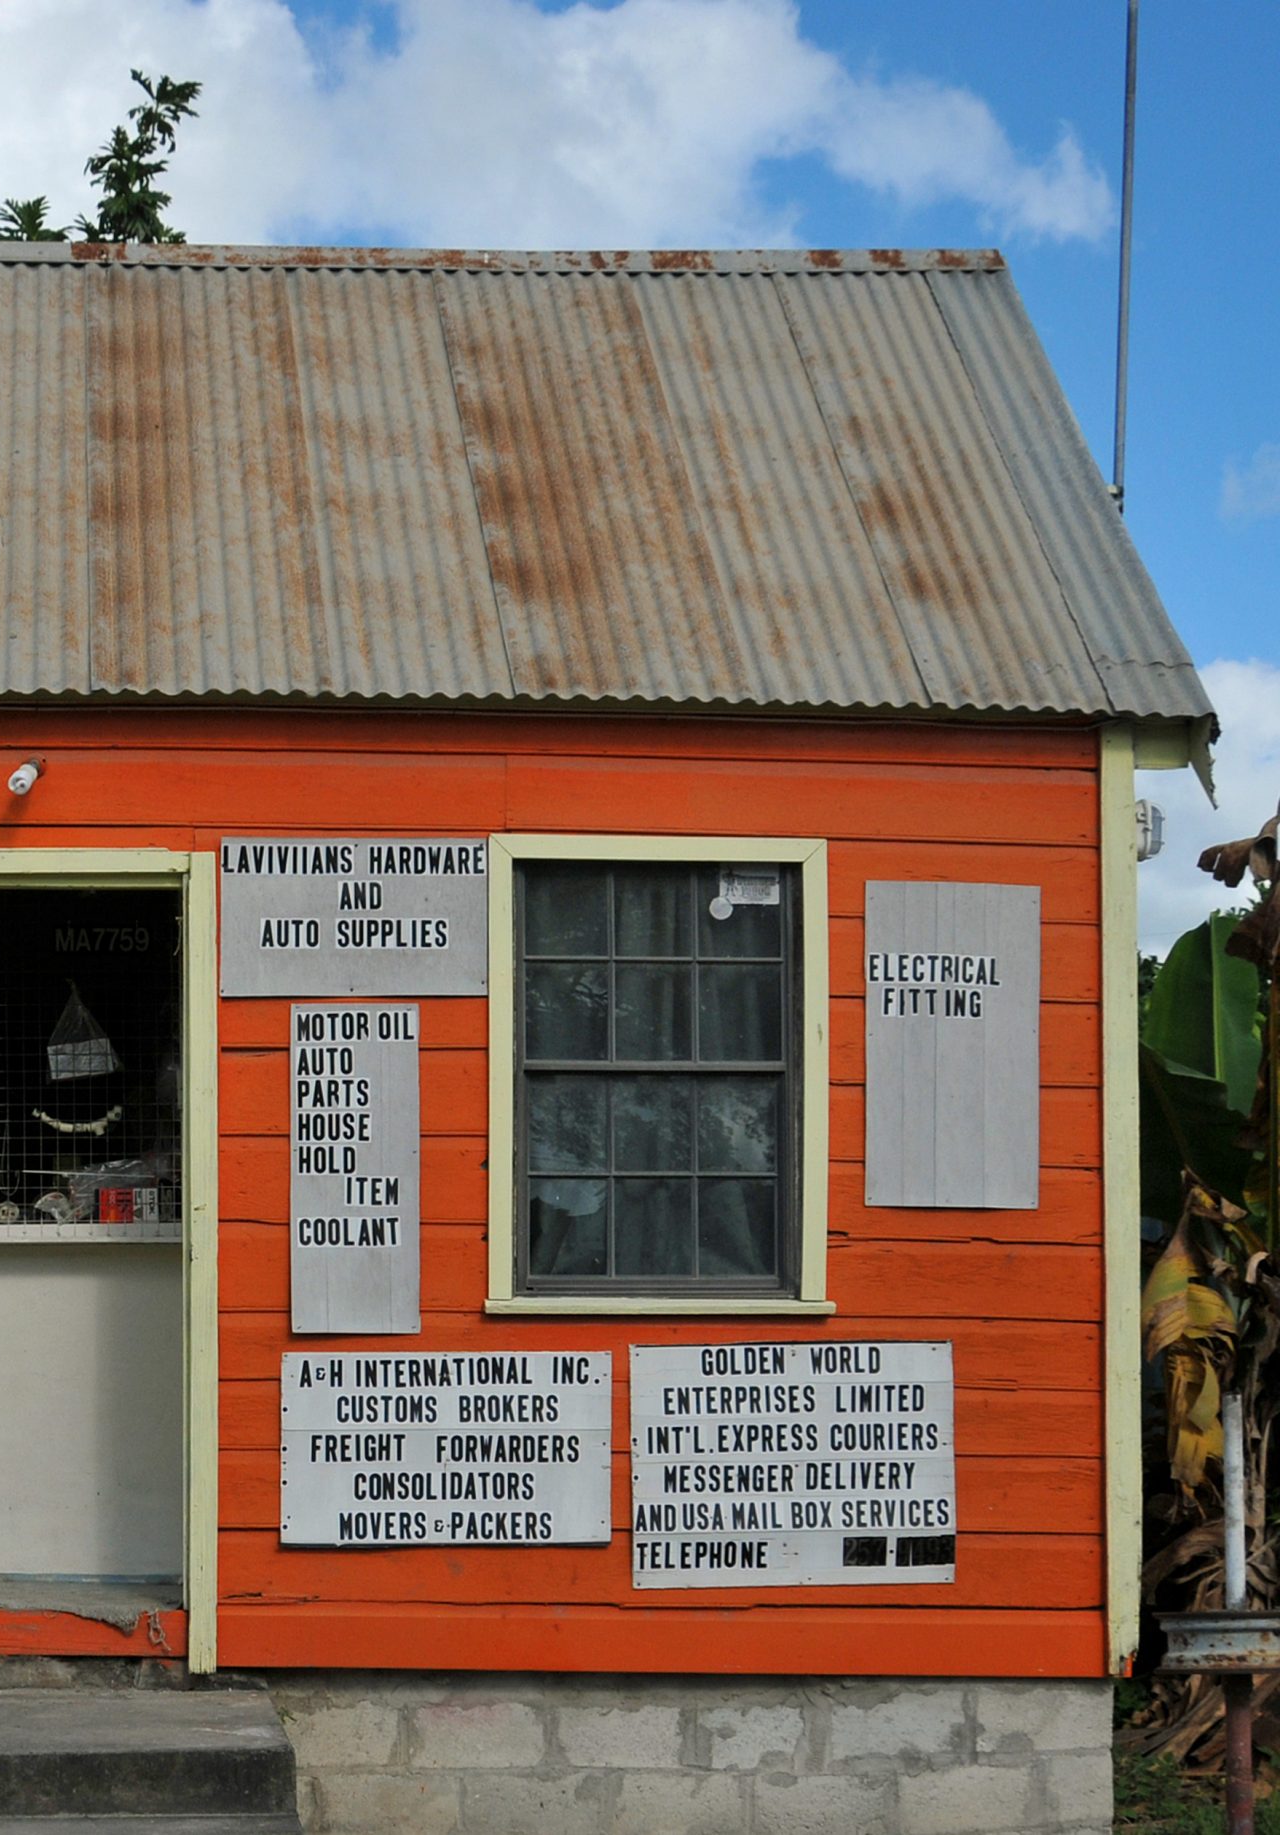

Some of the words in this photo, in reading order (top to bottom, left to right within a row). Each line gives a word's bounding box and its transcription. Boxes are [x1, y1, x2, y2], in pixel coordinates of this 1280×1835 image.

[222, 845, 353, 875] LAVIVIIANS
[369, 843, 485, 875] HARDWARE
[339, 882, 382, 910] AND
[55, 927, 151, 952] MA7759
[261, 919, 319, 948] AUTO
[337, 919, 447, 948] SUPPLIES
[869, 953, 1000, 986] ELECTRICAL
[297, 1012, 369, 1042] MOTOR
[378, 1012, 415, 1040] OIL
[297, 1047, 353, 1076] AUTO
[297, 1079, 369, 1109] PARTS
[298, 1112, 370, 1142] HOUSE
[298, 1145, 356, 1174] HOLD
[346, 1176, 399, 1206] ITEM
[299, 1217, 399, 1247] COOLANT
[355, 1356, 533, 1388] INTERNATIONAL
[552, 1356, 600, 1385] INC.
[701, 1346, 785, 1376] GOLDEN
[810, 1346, 880, 1374] WORLD
[337, 1395, 437, 1423] CUSTOMS
[459, 1394, 558, 1423] BROKERS
[663, 1385, 815, 1415] ENTERPRISES
[836, 1384, 924, 1413] LIMITED
[311, 1433, 406, 1463] FREIGHT
[436, 1434, 580, 1463] FORWARDERS
[830, 1423, 938, 1451] COURIERS
[354, 1471, 534, 1501] CONSOLIDATORS
[664, 1464, 793, 1493] MESSENGER
[806, 1462, 915, 1490] DELIVERY
[339, 1512, 427, 1540] MOVERS
[451, 1511, 552, 1540] PACKERS
[635, 1504, 676, 1532] AND
[682, 1503, 724, 1531] USA
[732, 1502, 782, 1530] MAIL
[791, 1501, 832, 1529] BOX
[841, 1498, 949, 1528] SERVICES
[636, 1540, 769, 1570] TELEPHONE
